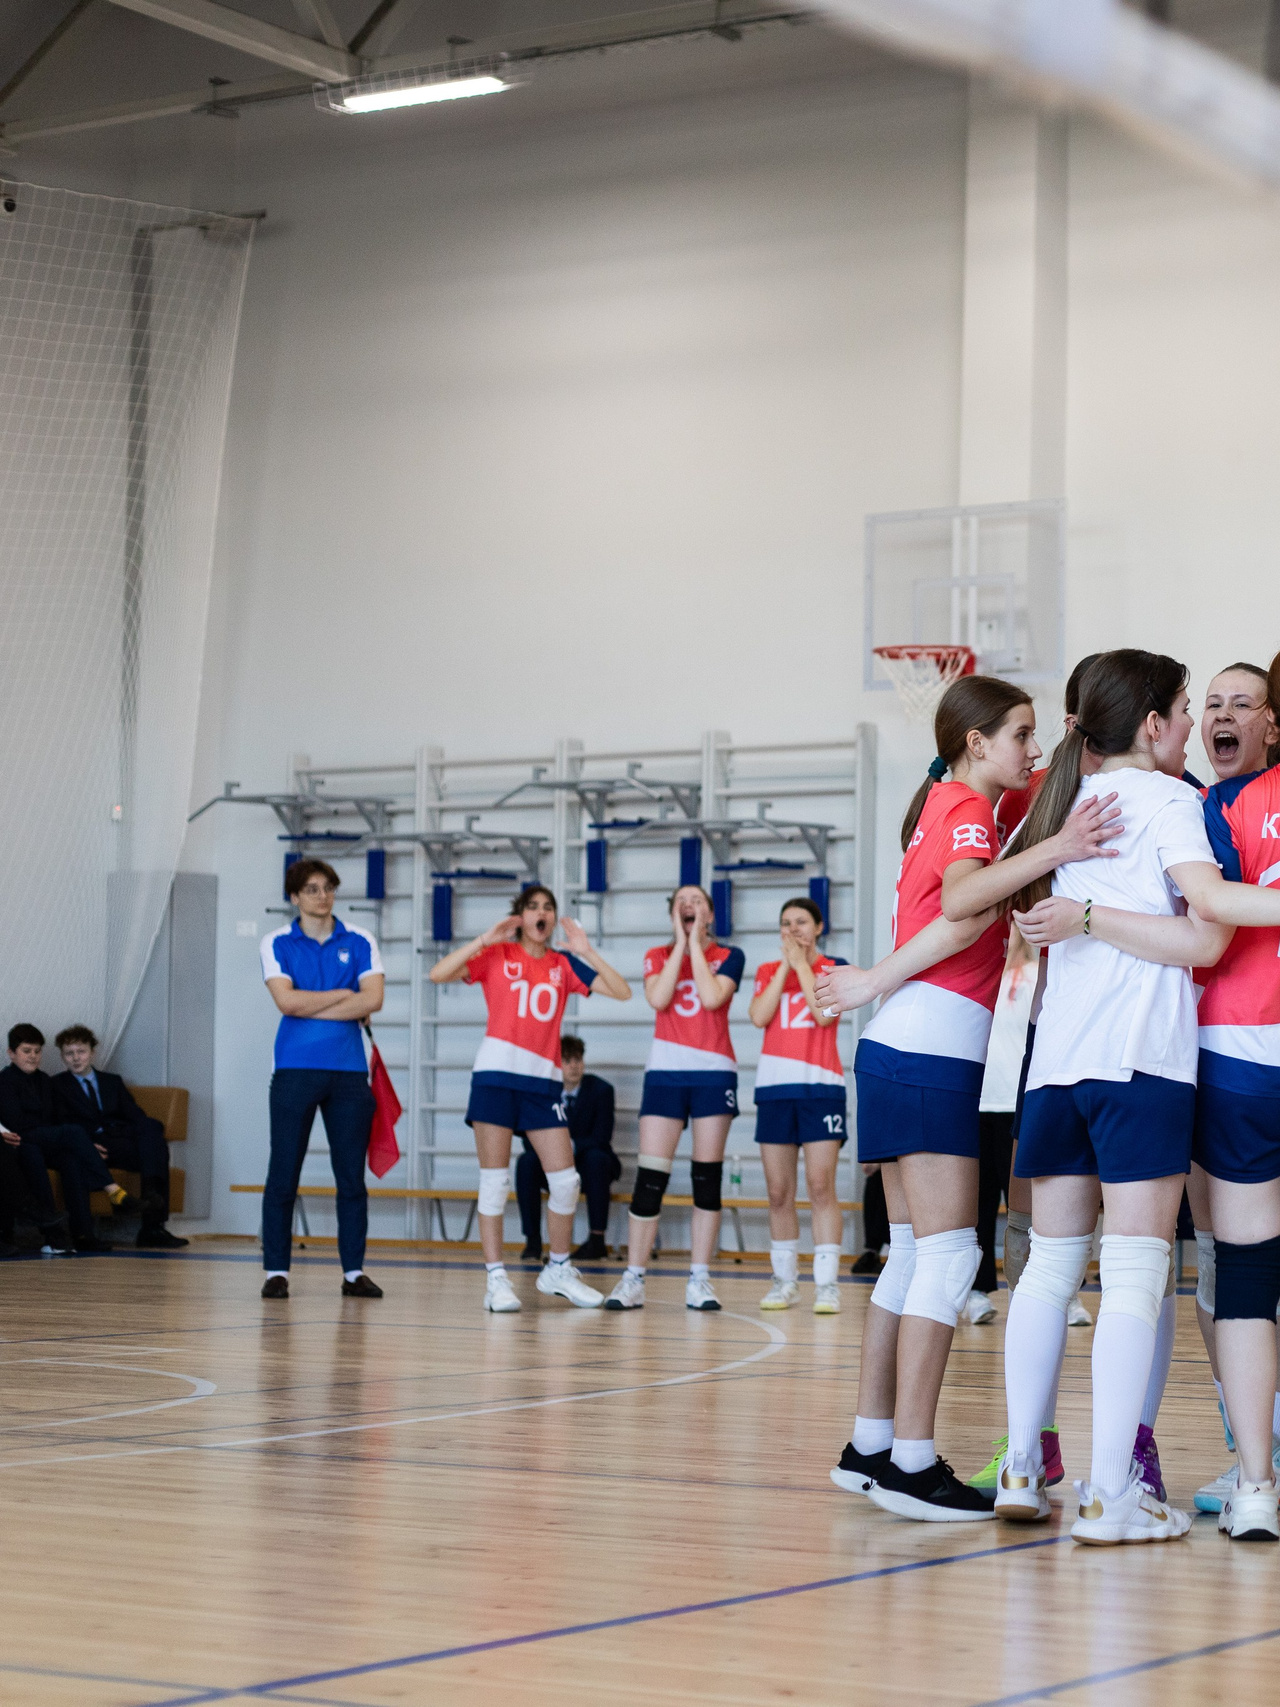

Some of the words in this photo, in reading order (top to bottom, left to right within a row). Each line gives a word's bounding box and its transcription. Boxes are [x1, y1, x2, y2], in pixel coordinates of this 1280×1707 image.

[509, 979, 559, 1023] 10
[673, 979, 702, 1018] 3
[780, 991, 816, 1030] 12
[725, 1089, 736, 1108] 3
[823, 1114, 844, 1134] 12
